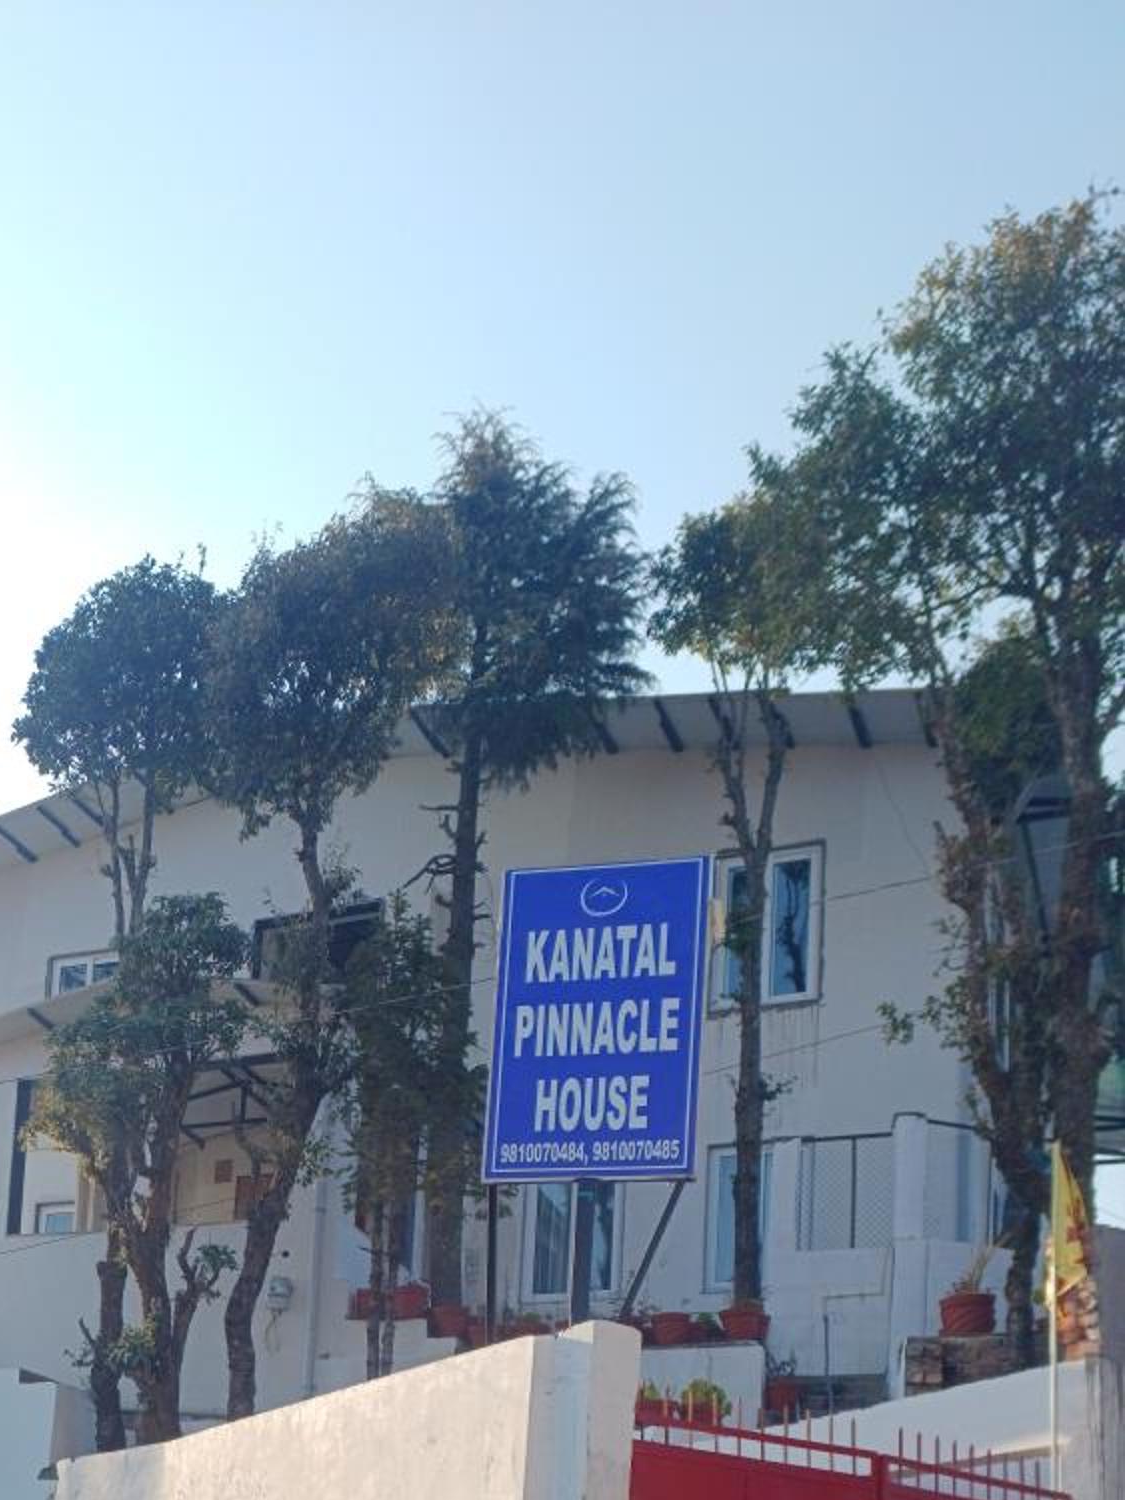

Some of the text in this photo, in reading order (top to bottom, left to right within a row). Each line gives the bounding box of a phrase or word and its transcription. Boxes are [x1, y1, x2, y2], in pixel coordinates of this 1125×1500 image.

[525, 923, 676, 983] KANATAL
[514, 998, 680, 1057] PINNACLE
[534, 1076, 650, 1132] HOUSE
[500, 1139, 680, 1165] 9810070484, 9810070485
